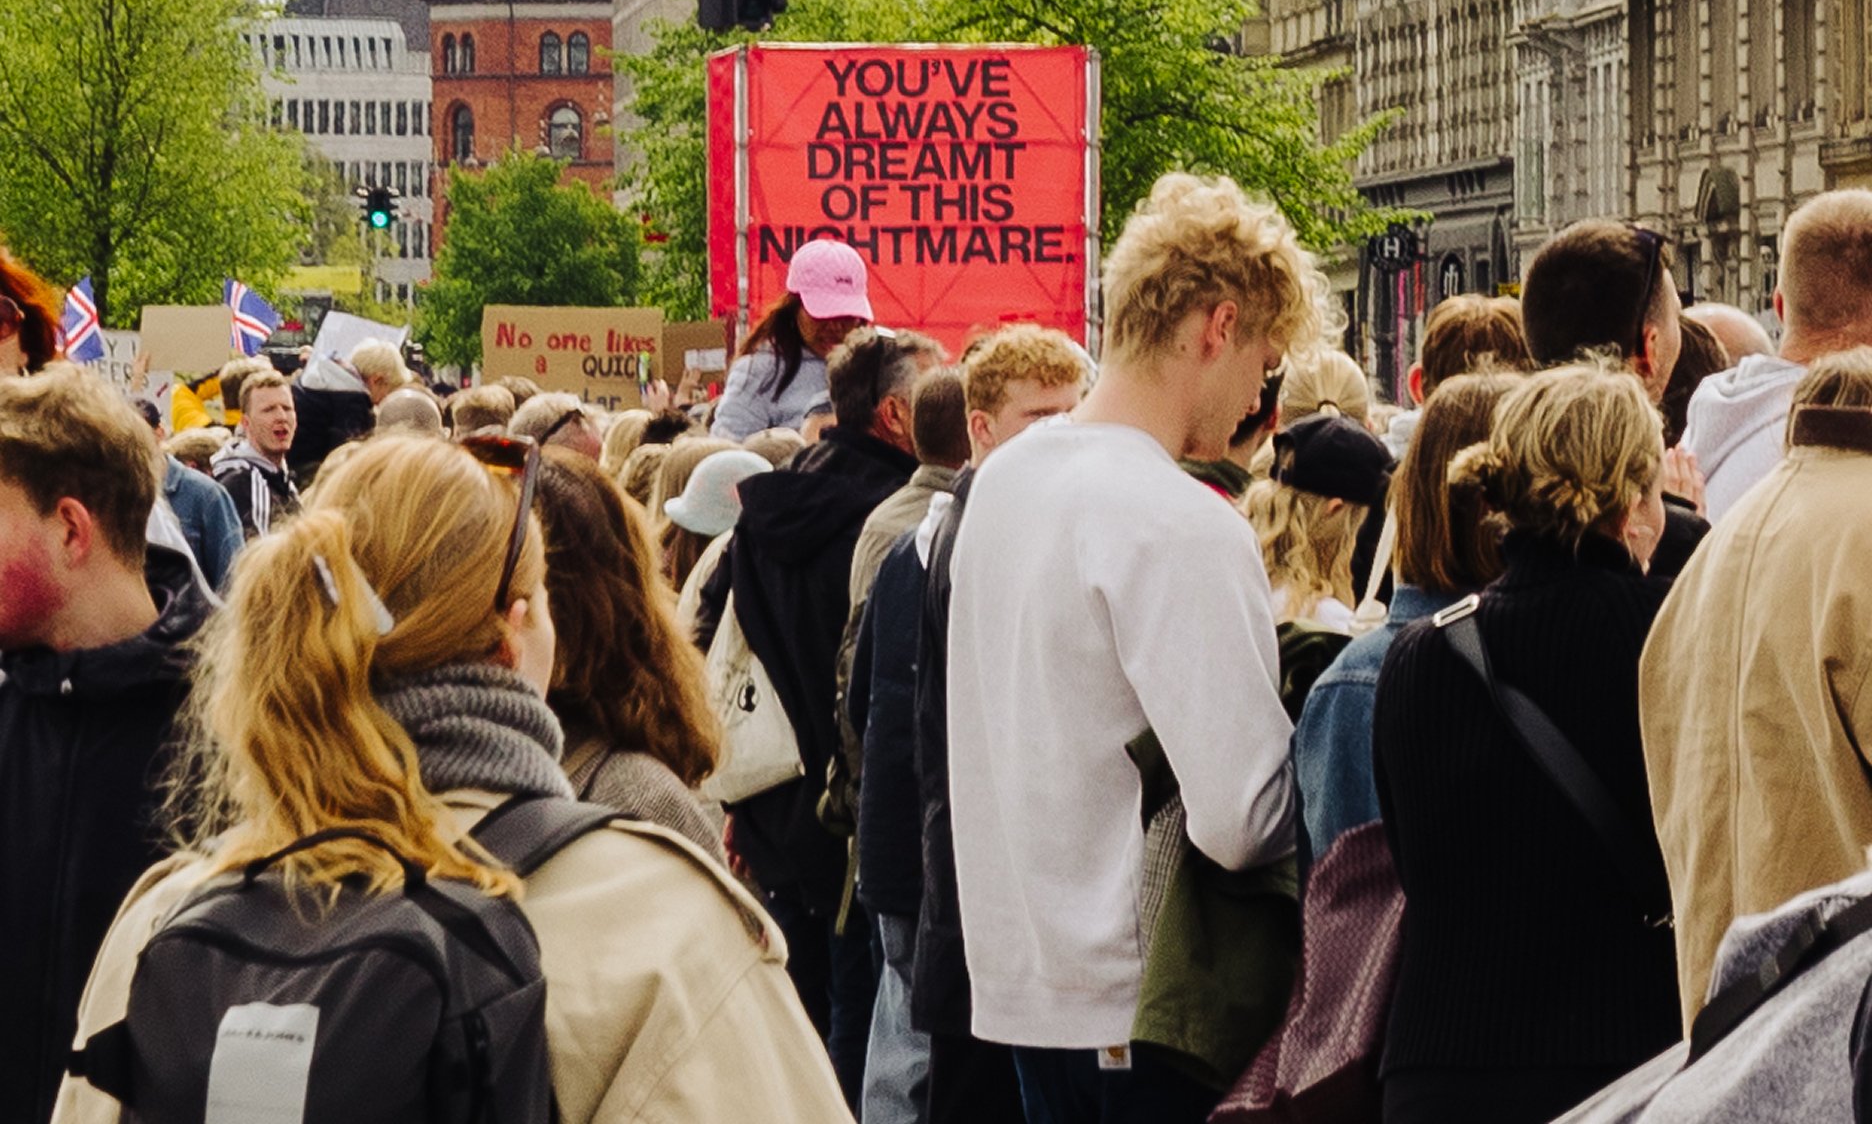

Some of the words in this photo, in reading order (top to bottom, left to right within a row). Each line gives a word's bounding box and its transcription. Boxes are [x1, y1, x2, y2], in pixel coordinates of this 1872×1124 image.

[825, 59, 1011, 97] YOU'VE
[816, 101, 1019, 140] ALWAYS
[807, 141, 1026, 181] DREAMT
[820, 184, 889, 222] OF
[899, 184, 1014, 222] THIS
[495, 322, 532, 349] No
[547, 332, 592, 353] one
[606, 328, 656, 354] likes
